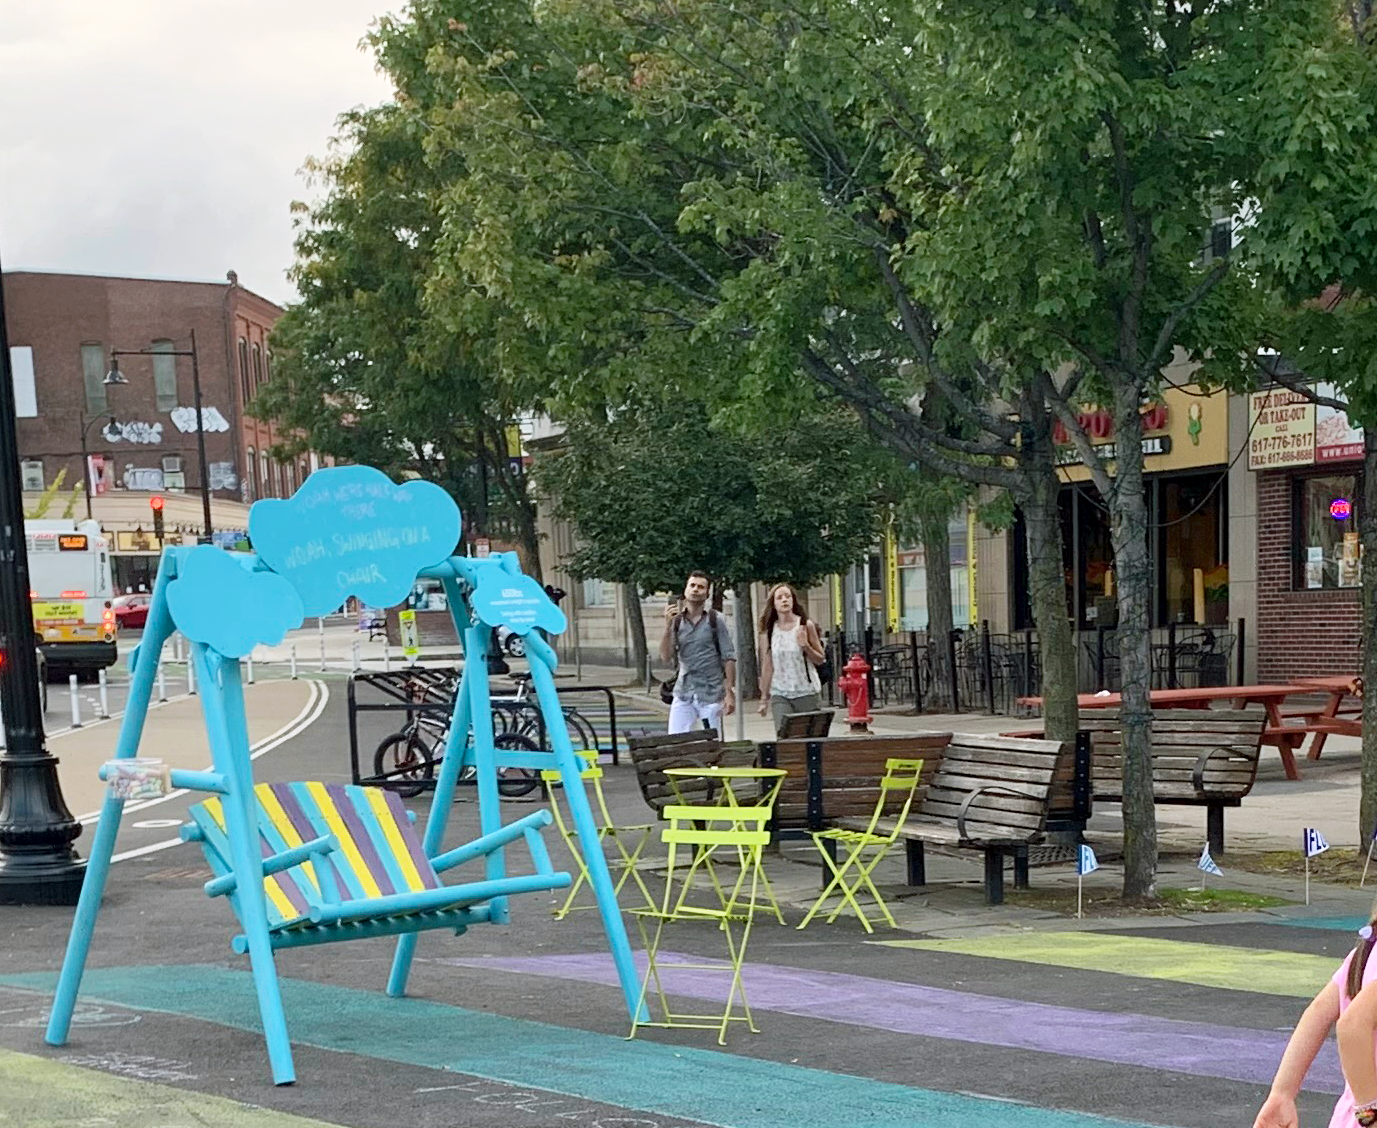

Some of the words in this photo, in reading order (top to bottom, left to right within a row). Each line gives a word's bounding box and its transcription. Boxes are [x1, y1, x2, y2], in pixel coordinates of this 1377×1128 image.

[1271, 407, 1306, 424] TAKE-OUT
[1251, 433, 1313, 453] 617-776-7617
[1251, 454, 1266, 467] FAX:
[337, 563, 387, 589] CHAIR
